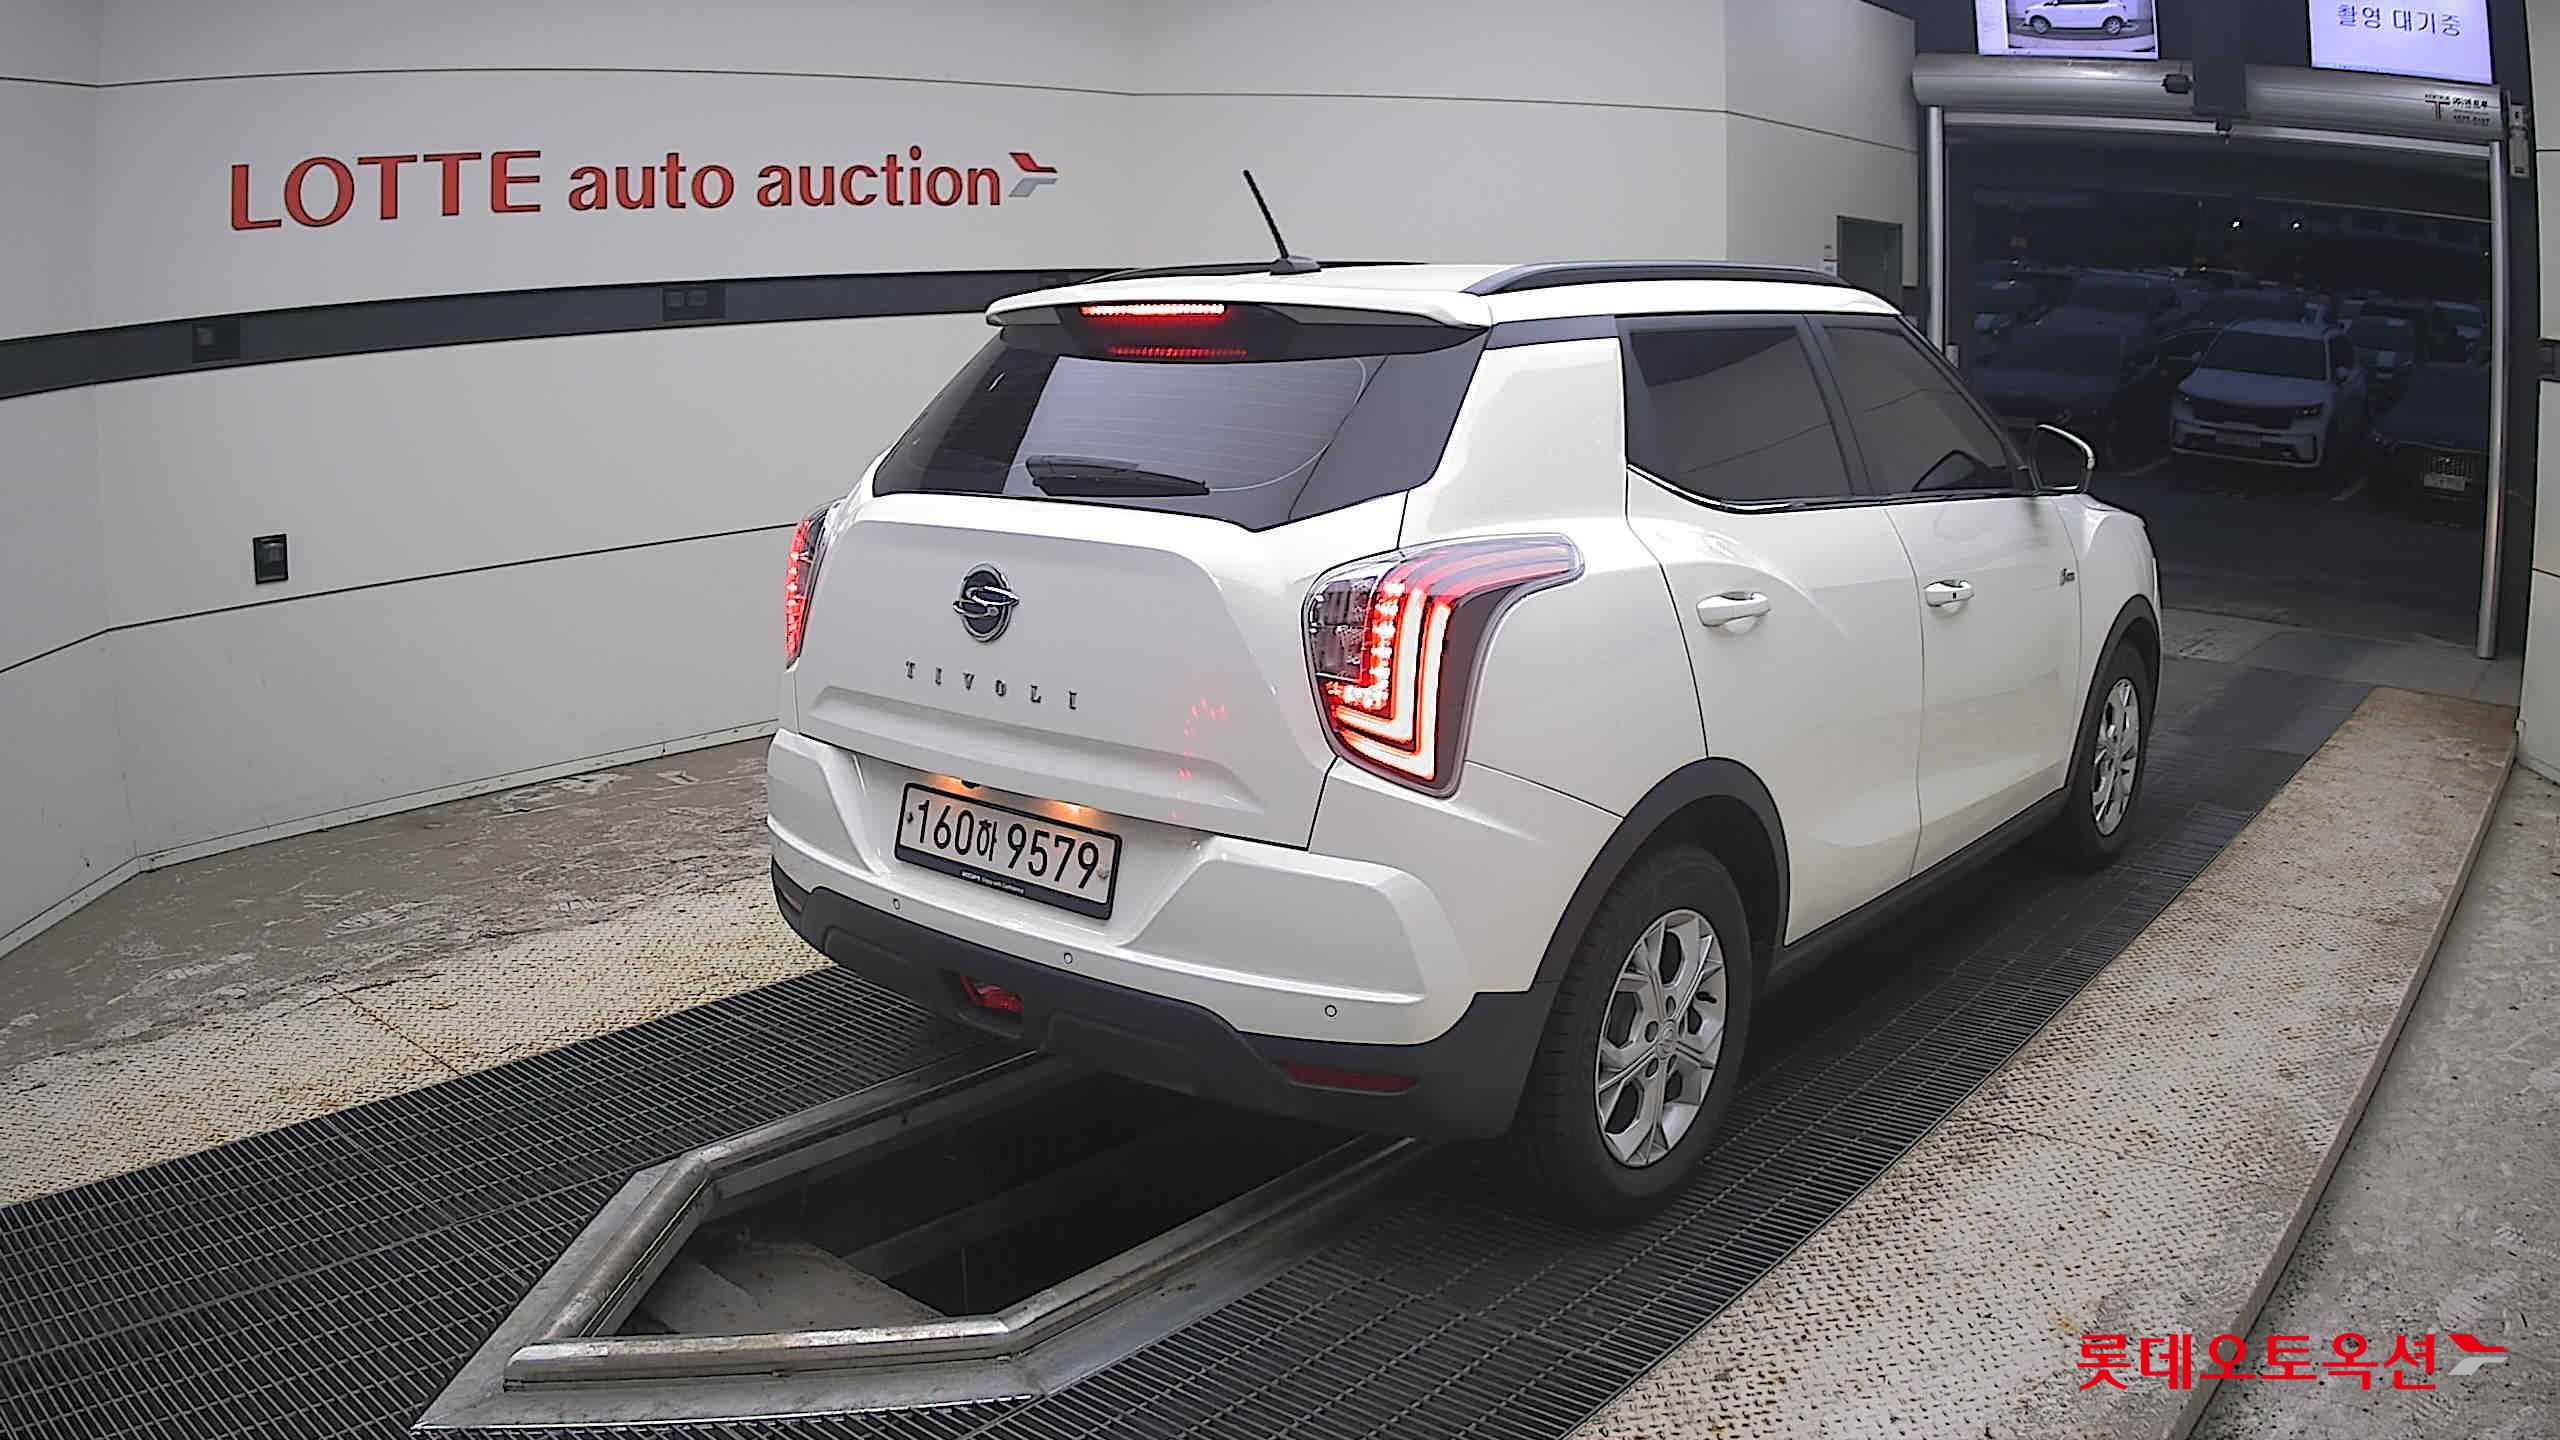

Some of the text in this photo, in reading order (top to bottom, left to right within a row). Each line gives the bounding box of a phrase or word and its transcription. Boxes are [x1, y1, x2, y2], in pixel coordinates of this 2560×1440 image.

[2393, 9, 2461, 37] 대기중
[230, 146, 1002, 231] LOTTE auto auction
[905, 660, 1077, 710] TIVOLI
[917, 799, 1100, 889] 160하 9579
